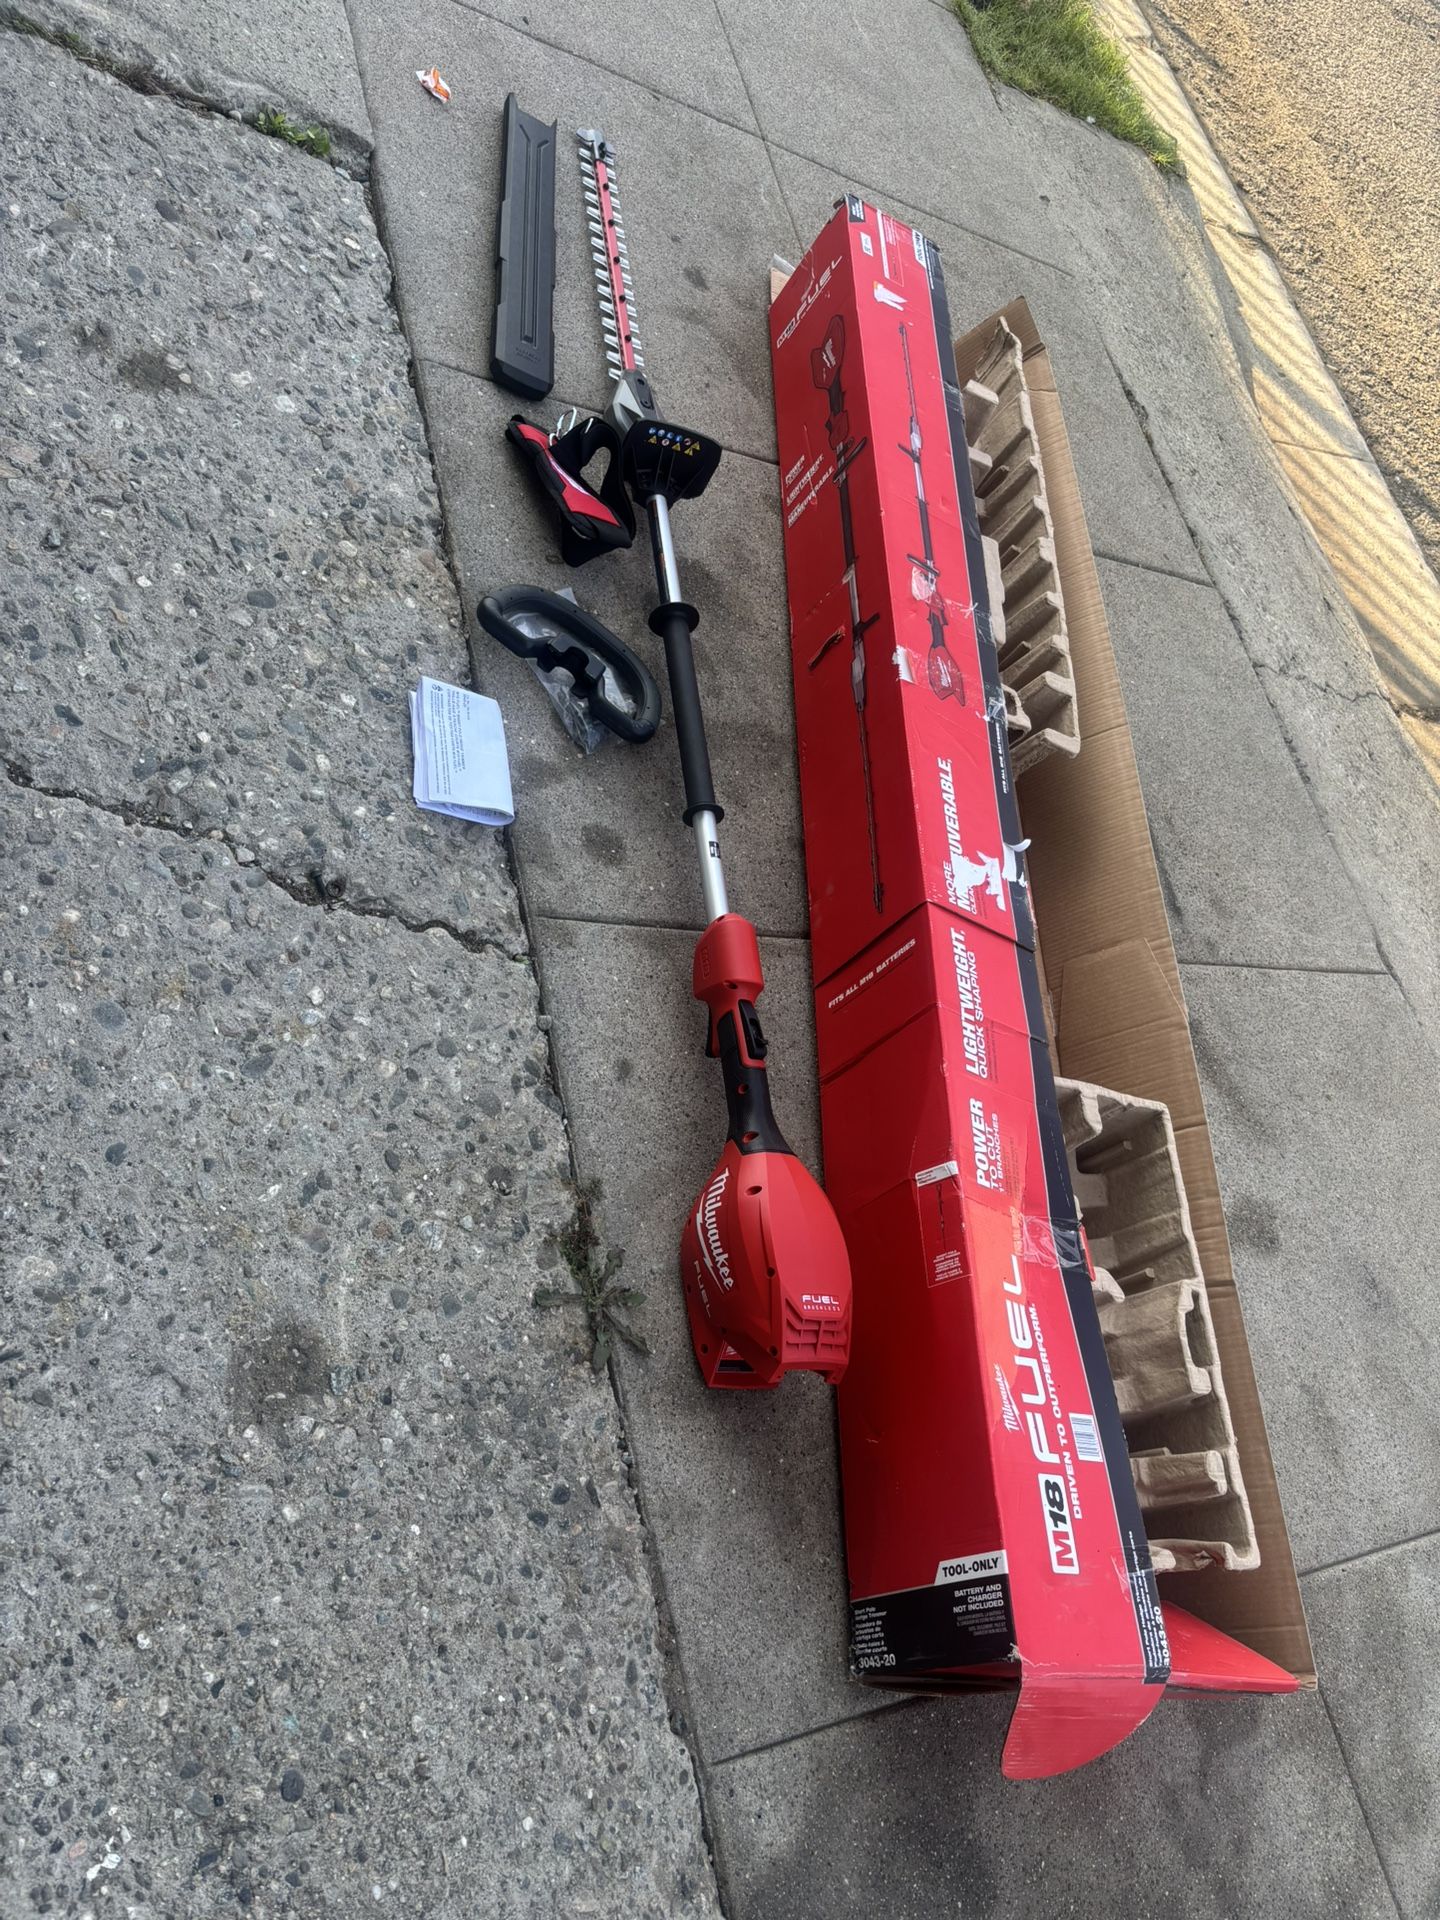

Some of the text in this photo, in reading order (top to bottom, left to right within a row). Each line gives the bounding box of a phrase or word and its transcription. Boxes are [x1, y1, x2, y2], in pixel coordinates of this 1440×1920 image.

[796, 256, 842, 321] FUEL
[938, 757, 972, 912] MUVERABLE,
[943, 860, 956, 905] MORE
[828, 994, 844, 1008] FITS
[846, 984, 858, 996] ALL
[876, 938, 916, 974] BATTERIES
[950, 927, 980, 1076] LIGHTWEIGHT,
[967, 951, 988, 1079] QUICK SHAPING
[970, 1098, 991, 1188] POWER
[985, 1123, 999, 1189] TO CUT
[992, 1113, 1004, 1179] BRANCHES
[703, 1167, 734, 1291] Milwaukee
[694, 1260, 711, 1318] FUEL
[802, 1294, 839, 1304] FUEL
[993, 1363, 1020, 1433] Milwaukee
[1003, 1254, 1075, 1567] M18 FUEL
[1028, 1303, 1082, 1520] DRIVEN TO OUTPERFORM.
[942, 1557, 1000, 1578] TOOL-ONLY
[954, 1584, 1002, 1598] BATTERY AND
[968, 1592, 1002, 1603] CHARGER
[953, 1600, 1004, 1614] NOT INCLUDED
[1153, 1606, 1170, 1668] 3043-20
[858, 1654, 896, 1668] 3043-20
